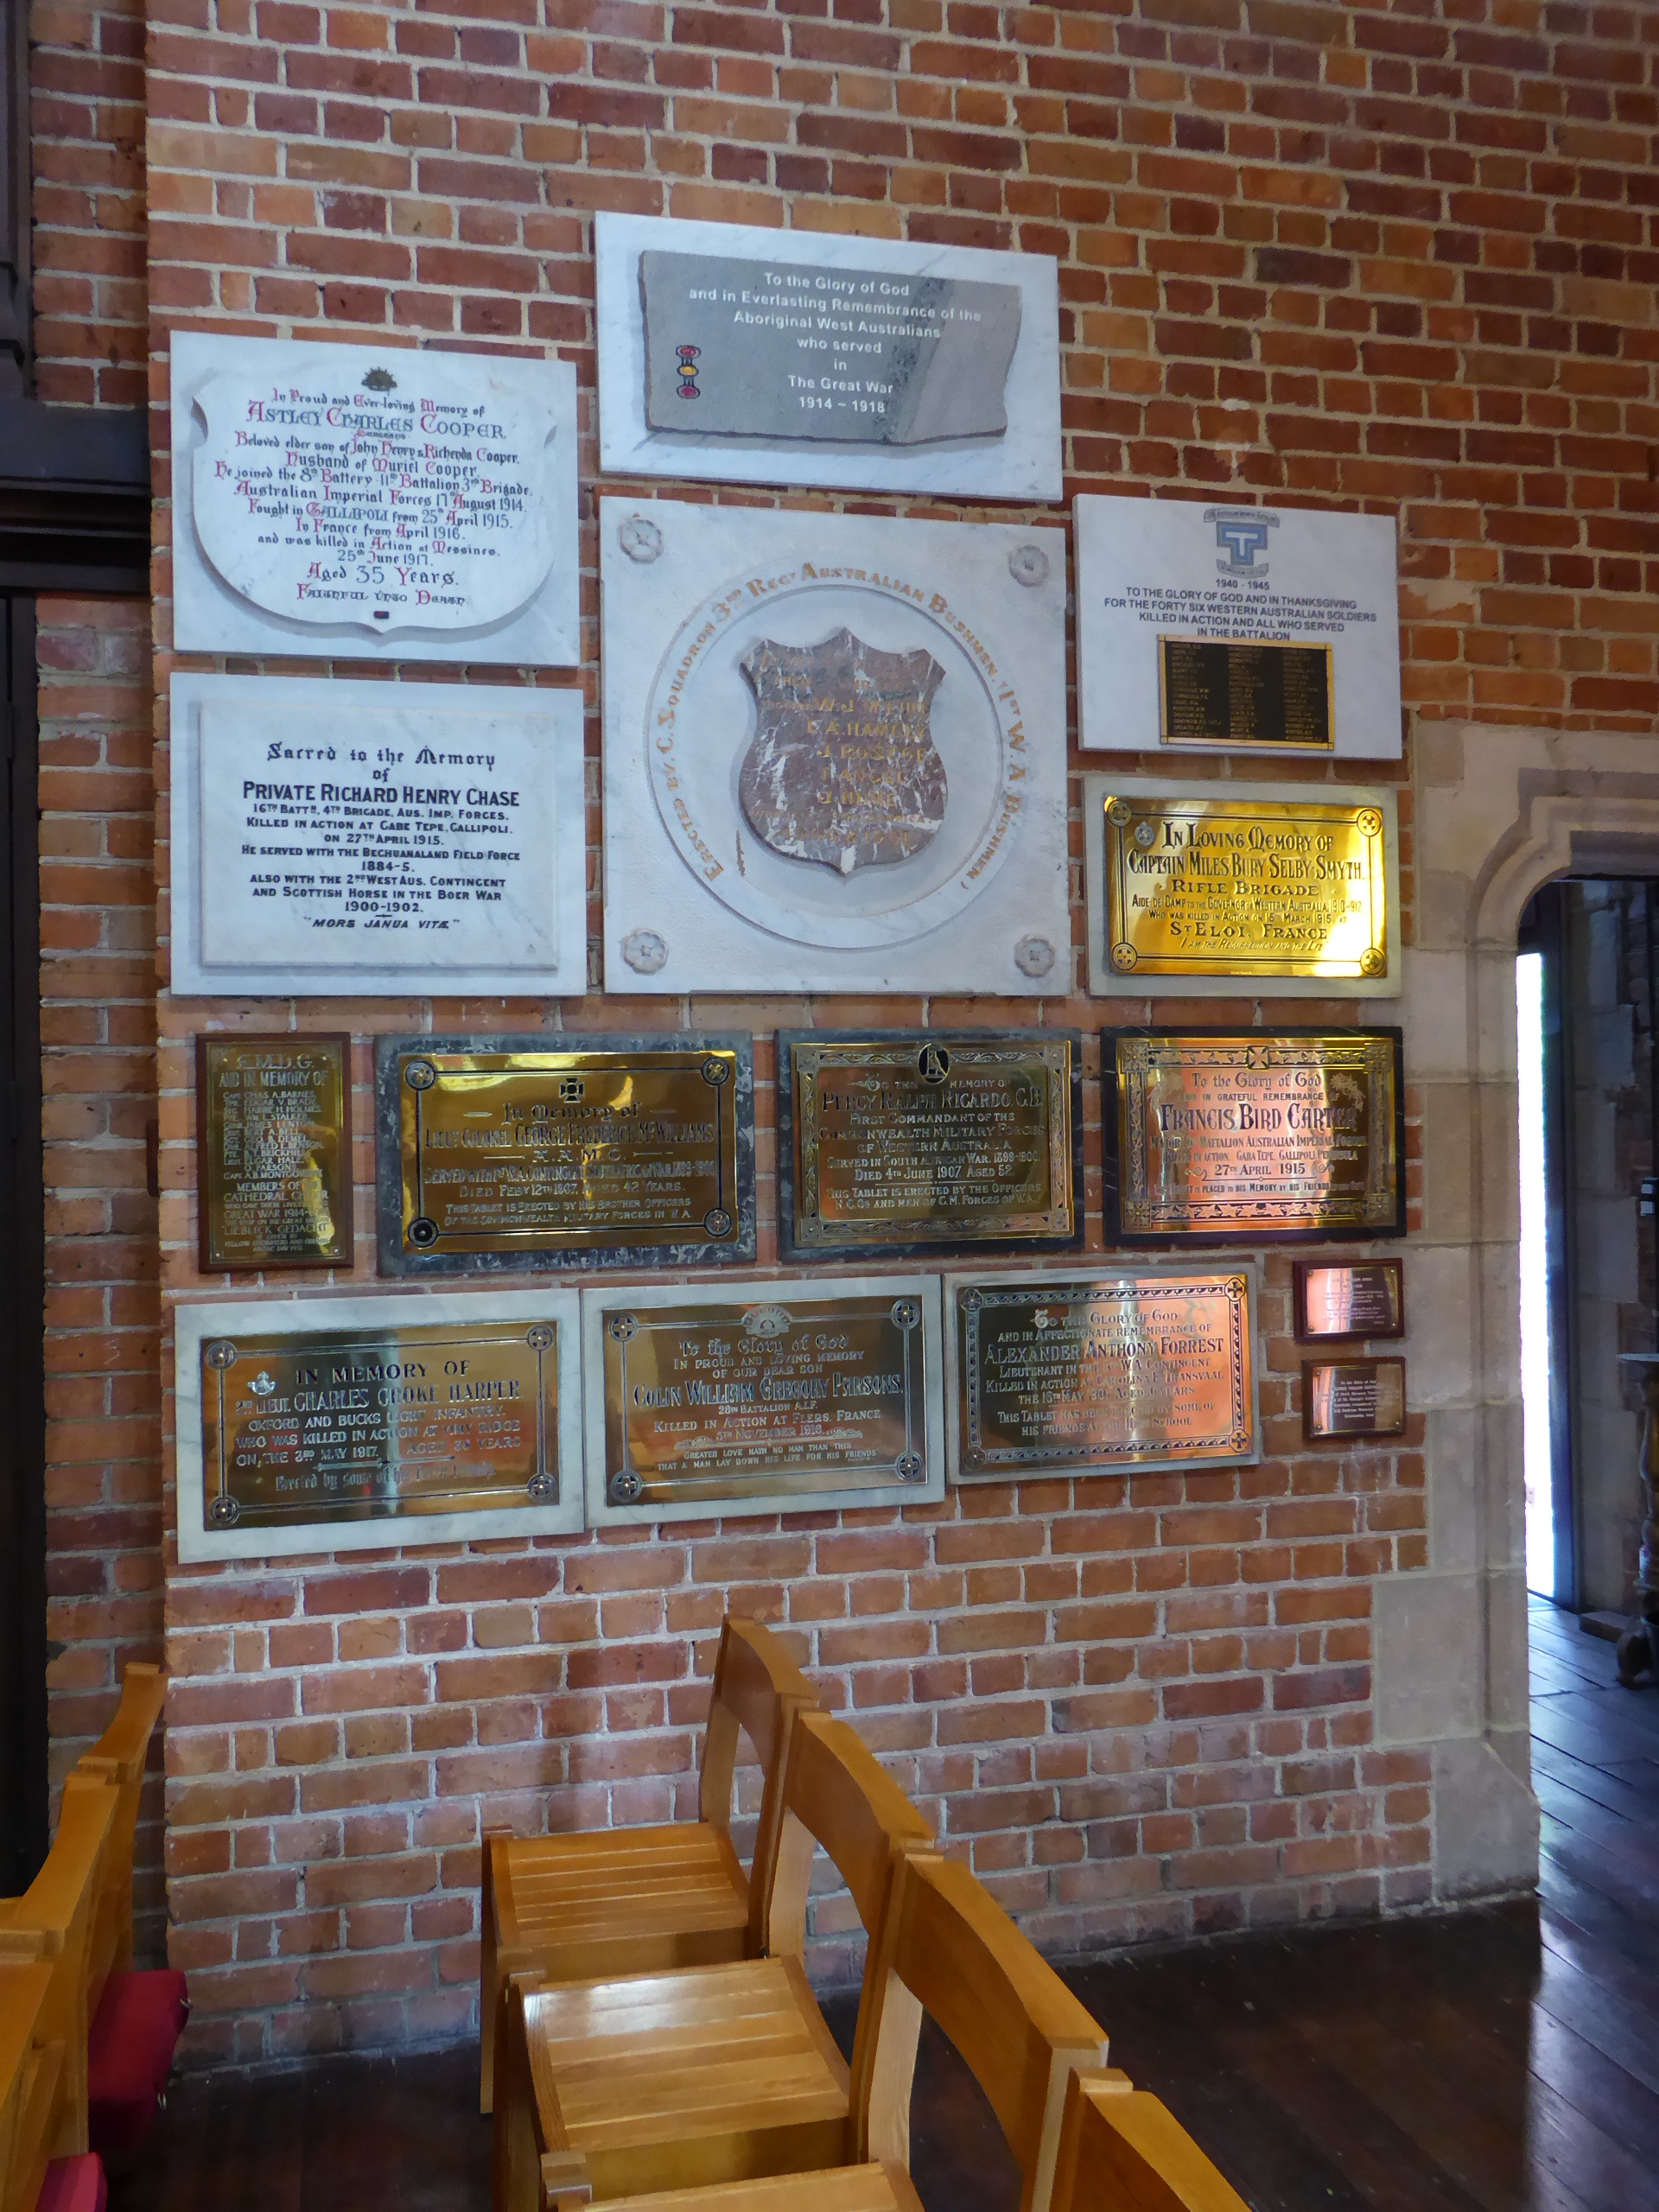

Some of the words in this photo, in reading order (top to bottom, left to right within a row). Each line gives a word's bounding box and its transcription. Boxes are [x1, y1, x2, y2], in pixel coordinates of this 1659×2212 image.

[765, 272, 781, 286] To
[787, 275, 810, 288] the
[816, 276, 855, 294] Glory
[861, 281, 874, 293] of
[880, 282, 910, 296] God
[690, 289, 716, 300] and
[722, 289, 735, 302] in
[741, 290, 826, 312] Everlasting
[832, 298, 935, 318] Remembrance
[941, 308, 955, 319] of
[959, 309, 982, 322] the
[734, 310, 811, 329] Aboriginal
[817, 318, 853, 332] West
[858, 321, 940, 338] Australians
[797, 336, 827, 349] who
[833, 340, 881, 353] served
[834, 359, 847, 371] in
[788, 375, 815, 389] The
[821, 377, 861, 392] Great
[866, 380, 893, 393] War
[272, 388, 286, 403] In
[289, 389, 327, 404] Proud
[332, 394, 350, 406] and
[354, 394, 415, 413] Ever-loving
[421, 398, 467, 417] Memory
[473, 405, 485, 417] of
[799, 397, 832, 410] 1914
[852, 400, 885, 413] 1918
[420, 414, 506, 439] COOPER
[307, 562, 346, 582] Aged
[356, 565, 385, 584] 35
[394, 567, 459, 588] Years.
[802, 563, 924, 602] AUSTRALIAN
[1216, 579, 1238, 588] 1940
[1248, 581, 1269, 590] 1945
[1126, 588, 1140, 596] TO
[1143, 588, 1163, 598] THE
[1166, 590, 1201, 601] GLORY
[1204, 592, 1217, 601] OF
[1220, 594, 1243, 603] GOD
[1246, 594, 1267, 604] AND
[1269, 596, 1279, 605] IN
[1281, 597, 1357, 609] THANKSGIVING
[1198, 627, 1207, 636] IN
[1210, 628, 1229, 638] THE
[1232, 630, 1289, 640] BATTALION
[267, 741, 337, 761] Sacred
[350, 749, 367, 761] to
[378, 748, 404, 766] the
[416, 745, 495, 772] Memory
[372, 767, 391, 783] of
[244, 781, 315, 801] PRIVATE
[321, 784, 397, 803] RICHARD
[403, 786, 461, 805] HENRY
[467, 788, 519, 806] CHASE
[1162, 822, 1183, 849] IN
[1186, 823, 1244, 849] LOVING
[1248, 826, 1313, 852] MEMORY
[1316, 836, 1333, 851] OF
[242, 845, 256, 855] HE
[260, 847, 302, 855] SERVED
[306, 848, 334, 856] WITH
[337, 849, 359, 857] THE
[363, 848, 448, 859] BECHUANALAND
[454, 849, 483, 860] FIELD
[488, 851, 520, 861] FORCE
[1128, 849, 1185, 874] CAPTAIN
[1190, 851, 1230, 875] MILES
[1232, 853, 1265, 877] BURY
[362, 861, 415, 872] 1884-5.
[1172, 880, 1227, 893] RIFLE
[1234, 880, 1319, 896] BRIGADE
[346, 901, 423, 912] 1900-1902.
[1262, 924, 1327, 939] FRANCE
[260, 1071, 310, 1086] MEMORY
[1192, 1073, 1207, 1087] To
[1213, 1073, 1230, 1087] the
[1235, 1071, 1271, 1090] Glory
[1279, 1073, 1290, 1087] of
[1295, 1071, 1321, 1087] God
[501, 1103, 524, 1125] In
[531, 1104, 612, 1122] Memory
[621, 1102, 642, 1117] of
[1161, 1103, 1236, 1133] FRANCIS
[1239, 1103, 1281, 1132] BIRD
[855, 1169, 882, 1180] DIED
[904, 1167, 933, 1179] JUNE
[967, 1167, 995, 1177] AGED
[1215, 1165, 1237, 1176] 27TH
[1239, 1164, 1271, 1175] APRIL
[1280, 1163, 1305, 1174] 1915
[1090, 1312, 1134, 1325] GLORY
[1135, 1313, 1149, 1322] OF
[1153, 1309, 1178, 1322] GOD
[679, 1340, 700, 1357] To
[708, 1338, 731, 1357] the
[738, 1338, 784, 1354] Glory
[792, 1333, 810, 1351] of
[816, 1333, 849, 1350] God
[984, 1344, 1081, 1364] ALEXANDER
[1084, 1340, 1157, 1358] ANTHONY
[1160, 1336, 1224, 1356] FORREST
[296, 1369, 318, 1384] IN
[332, 1363, 429, 1384] MEMORY
[444, 1360, 470, 1376] OF
[294, 1389, 369, 1412] CHARLES
[633, 1383, 682, 1408] COLIN
[685, 1380, 754, 1405] WILLIAM
[760, 1376, 830, 1401] GREGORY
